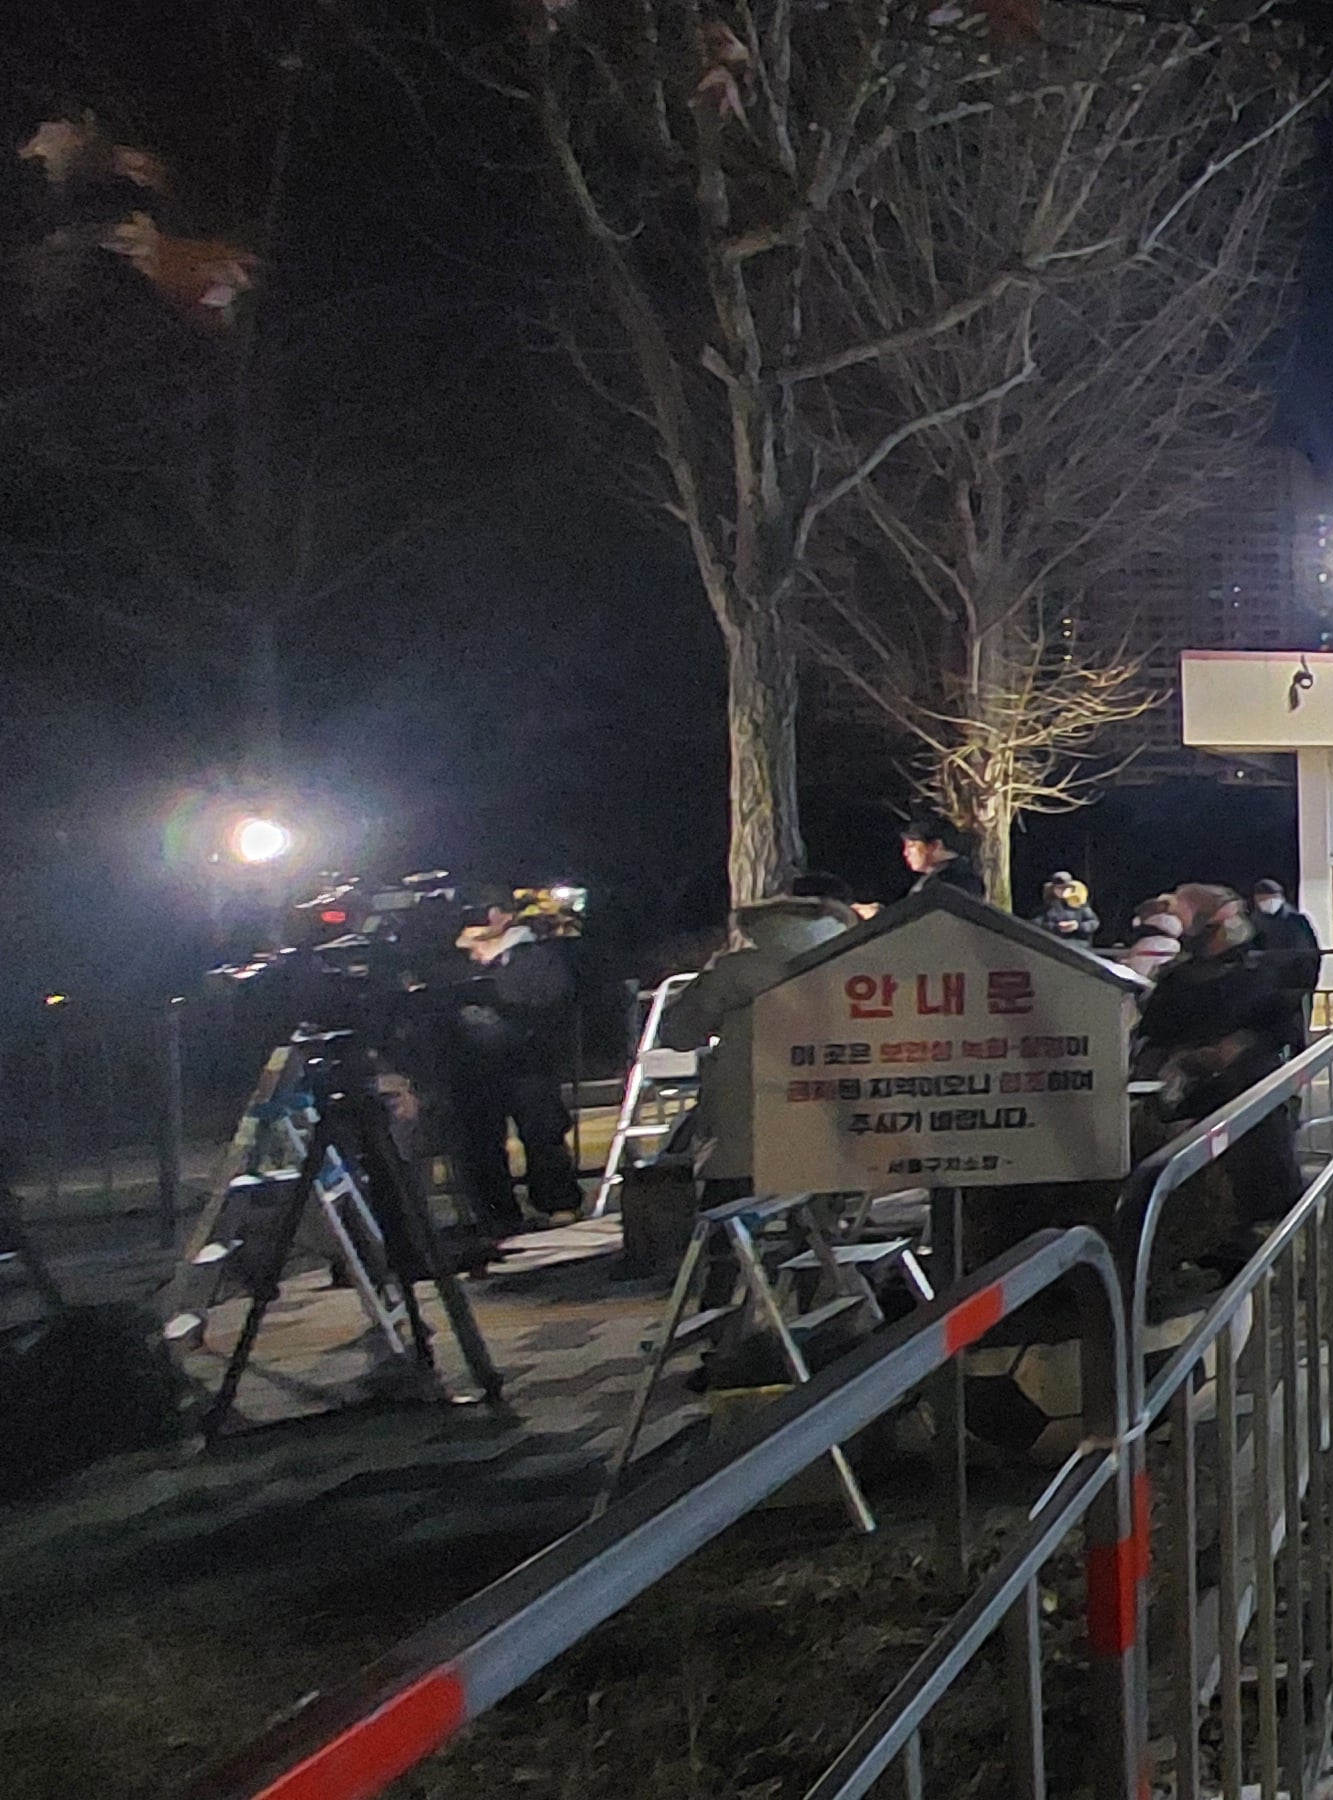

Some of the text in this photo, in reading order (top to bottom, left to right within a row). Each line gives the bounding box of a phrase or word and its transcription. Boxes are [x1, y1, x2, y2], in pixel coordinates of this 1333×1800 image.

[791, 1044, 815, 1066] 이
[823, 1042, 871, 1066] 곳은
[868, 1073, 991, 1098] 지역이오니
[849, 1108, 923, 1135] 주시기
